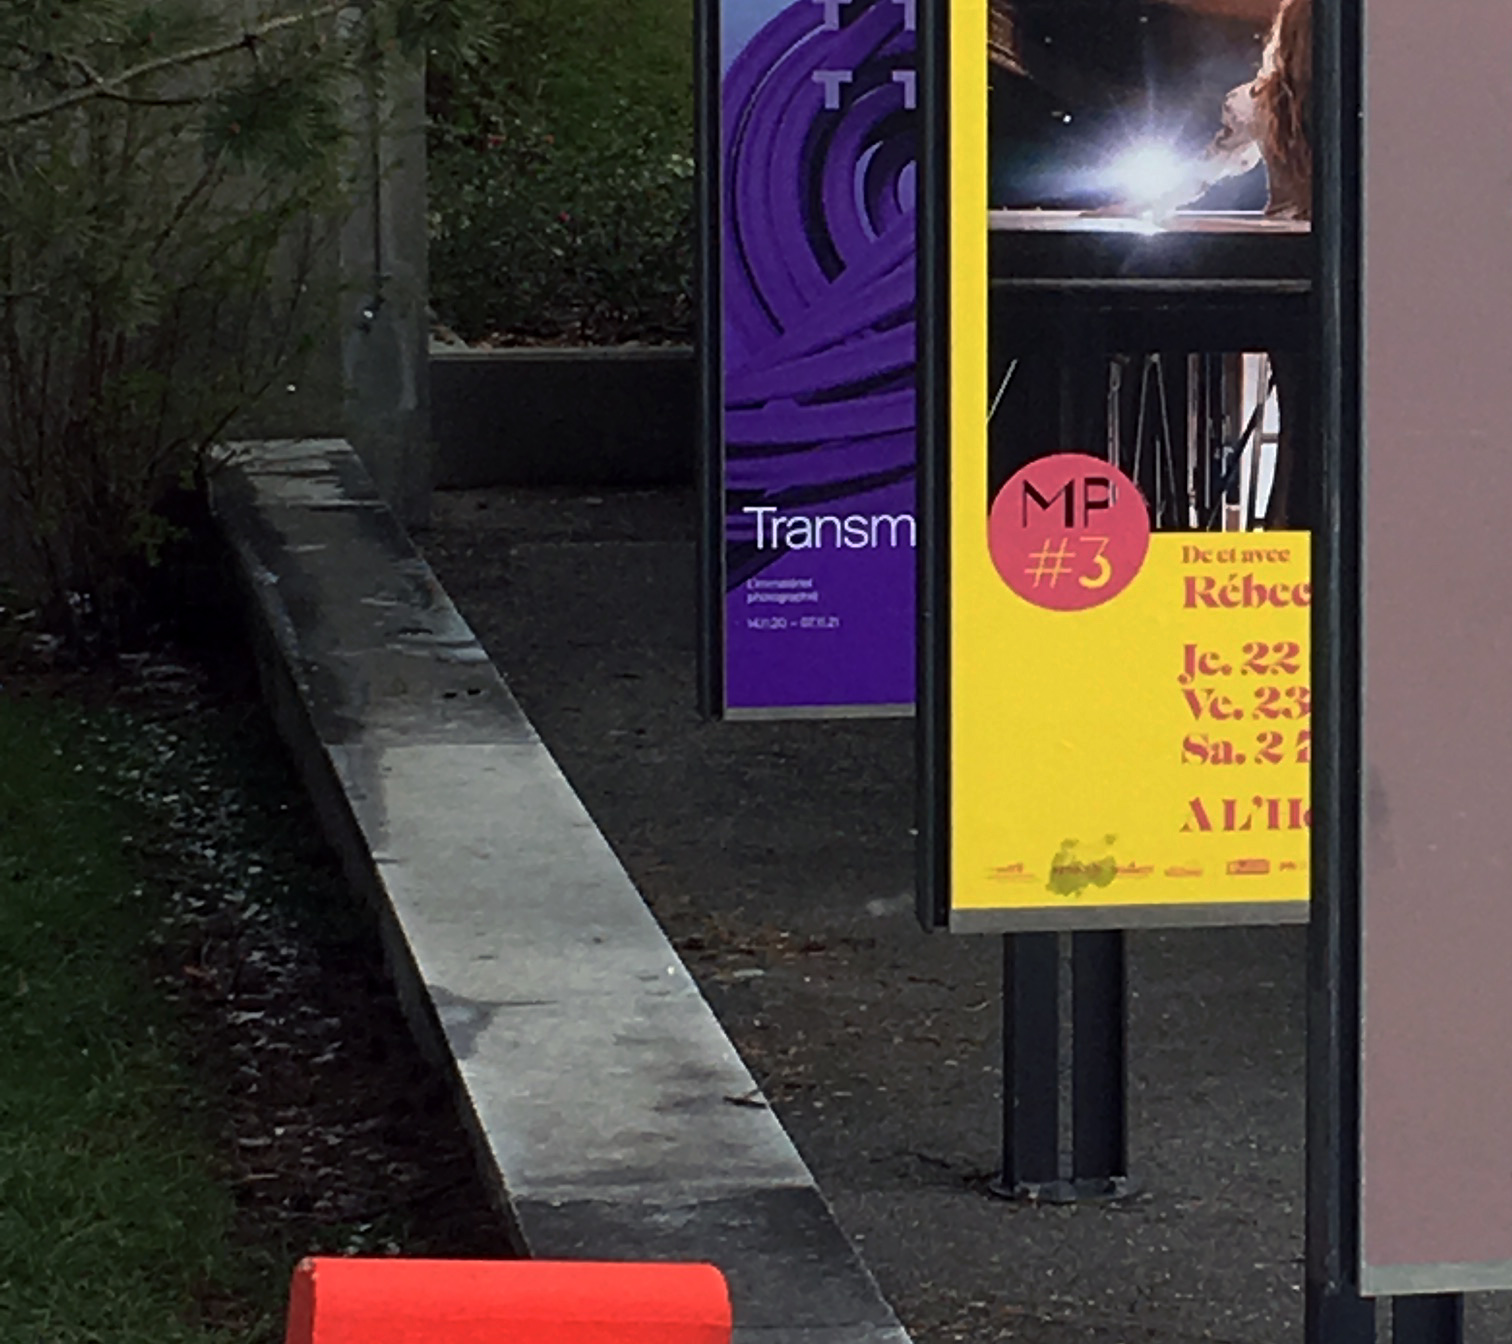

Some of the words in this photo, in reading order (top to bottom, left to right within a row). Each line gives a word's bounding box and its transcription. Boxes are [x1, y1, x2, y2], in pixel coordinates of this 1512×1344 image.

[1022, 476, 1117, 528] MP
[742, 506, 917, 550] Transm
[1024, 537, 1112, 590] #3
[1241, 641, 1301, 676] 22
[1252, 686, 1311, 721] 23
[1181, 732, 1246, 766] Sa.
